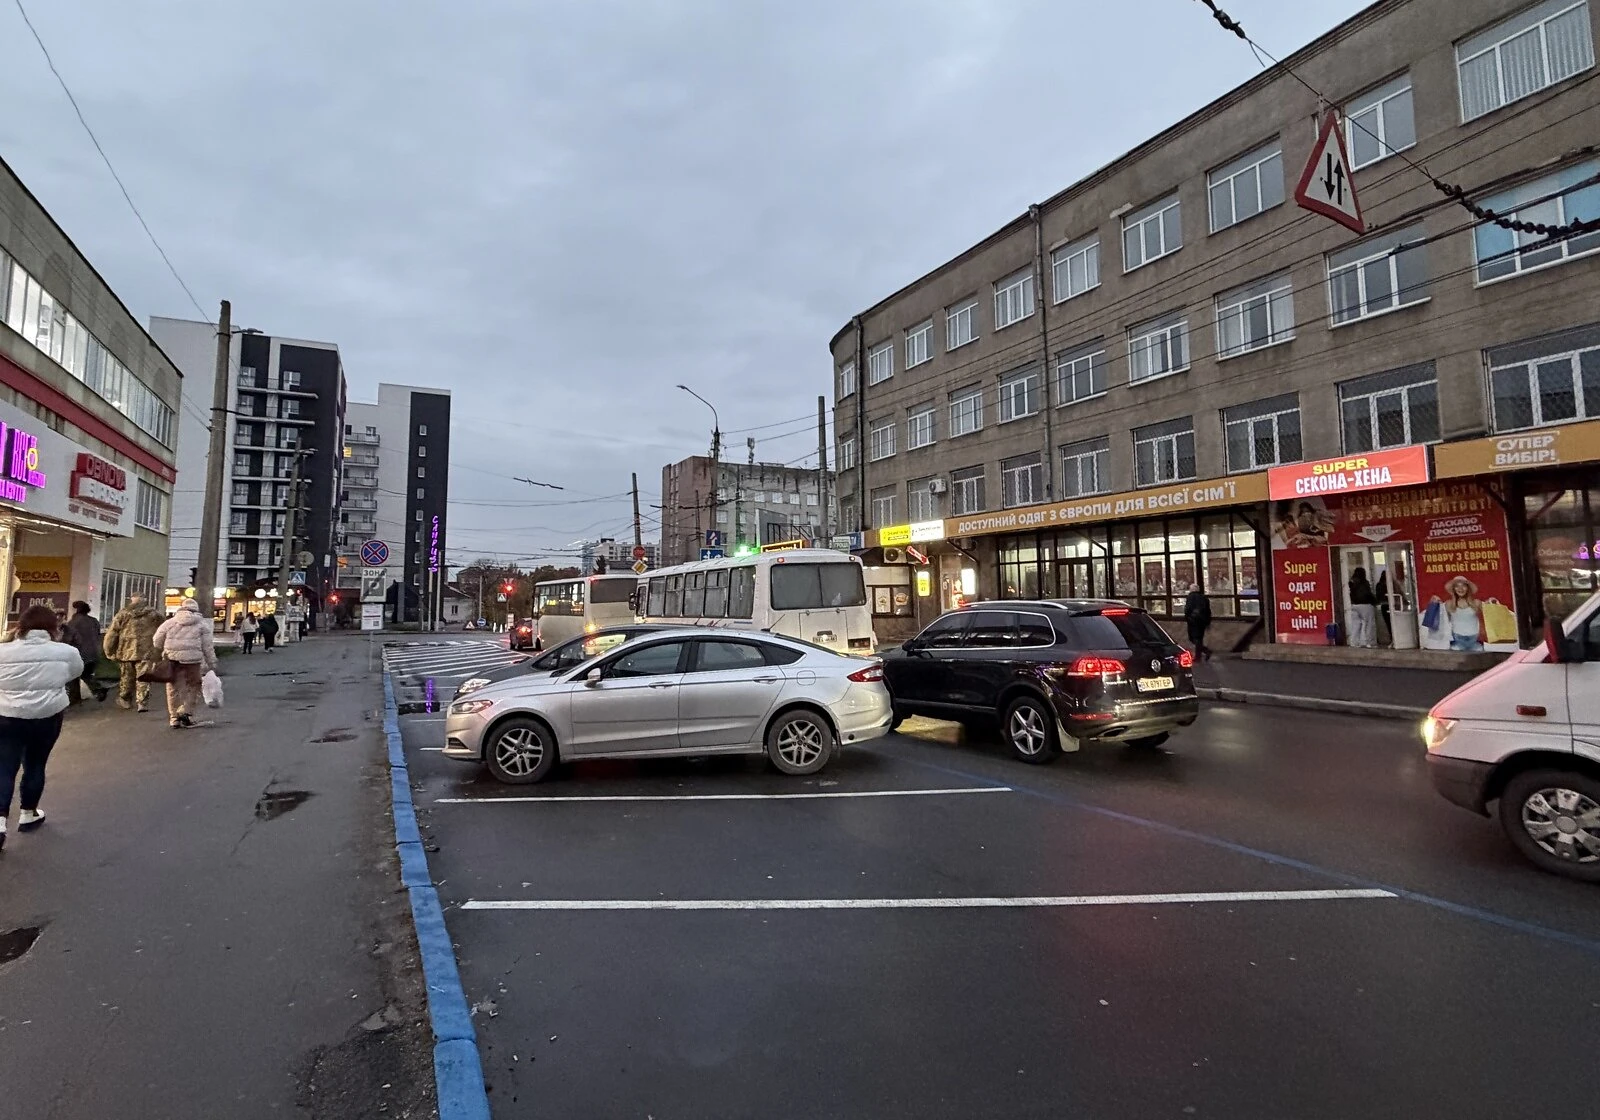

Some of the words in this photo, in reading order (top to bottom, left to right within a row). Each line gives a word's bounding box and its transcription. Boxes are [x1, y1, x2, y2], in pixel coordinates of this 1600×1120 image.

[1497, 435, 1554, 451] СУПЕР
[1495, 449, 1556, 465] ВИБІР!
[1312, 458, 1369, 475] SUPER
[958, 513, 1016, 533] ДОСТУПНИЙ
[1018, 511, 1047, 526] ОДЯГ
[1049, 510, 1057, 520] З
[1059, 502, 1112, 519] ЄВРОПИ
[1115, 497, 1144, 514] ДЛЯ
[1148, 488, 1189, 509] ВСІЄЇ
[1431, 517, 1478, 529] ЛАСКАВО
[1284, 561, 1317, 576] Super
[1288, 581, 1316, 594] одяг
[1280, 601, 1292, 610] по
[1293, 597, 1327, 613] Super
[1291, 615, 1318, 630] ціні!
